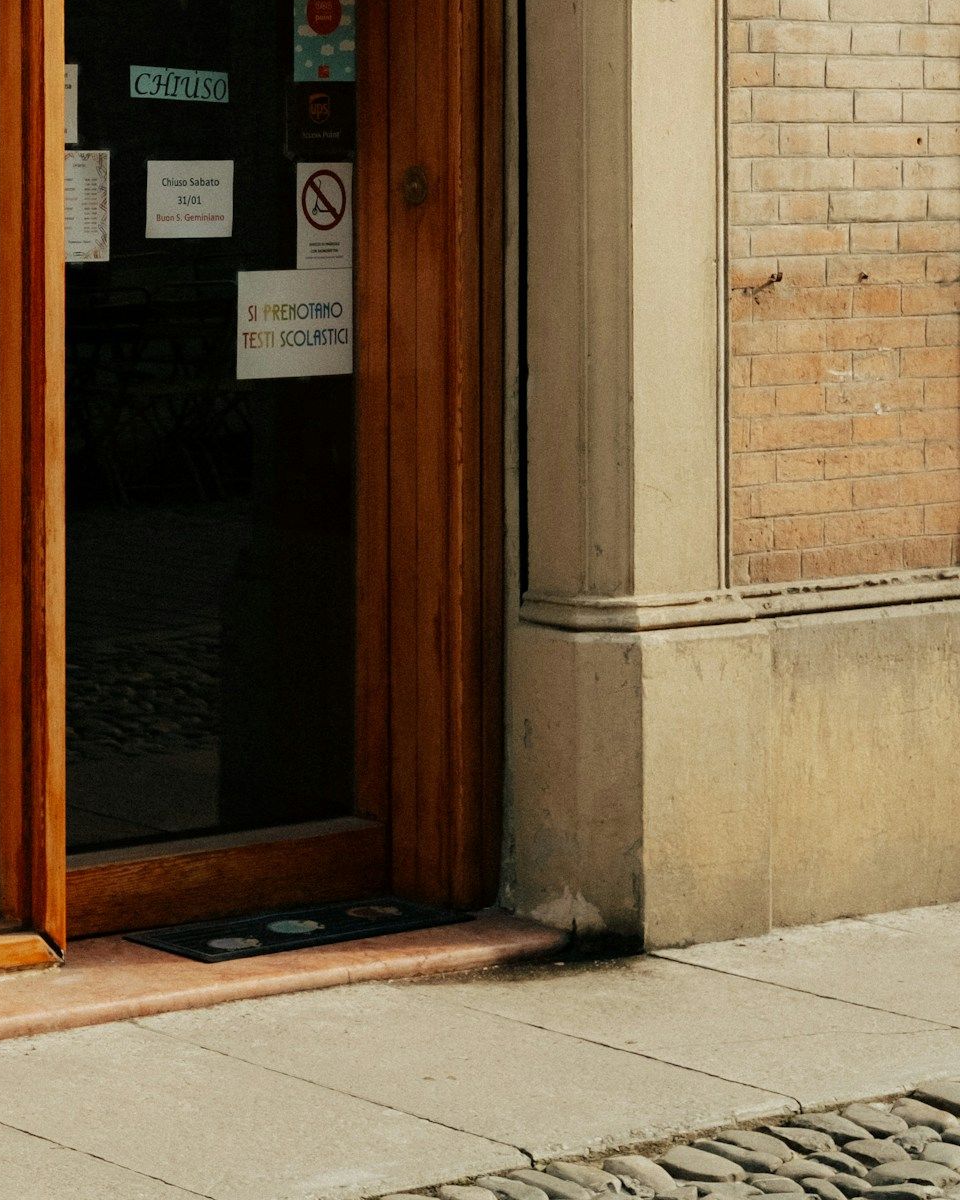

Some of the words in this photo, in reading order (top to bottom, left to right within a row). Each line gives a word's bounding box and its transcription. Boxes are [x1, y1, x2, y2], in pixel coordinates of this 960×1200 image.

[134, 71, 227, 100] CHIUSO
[161, 176, 188, 188] Chiuso
[189, 176, 220, 187] Sabato
[177, 194, 202, 206] 31/01
[156, 212, 175, 222] Buon
[176, 212, 183, 222] S.
[184, 211, 225, 222] Geminiano
[248, 304, 258, 322] SI
[263, 302, 343, 322] PRENOTANO
[242, 330, 275, 349] TESTI
[280, 328, 349, 347] SCOLASTICI
